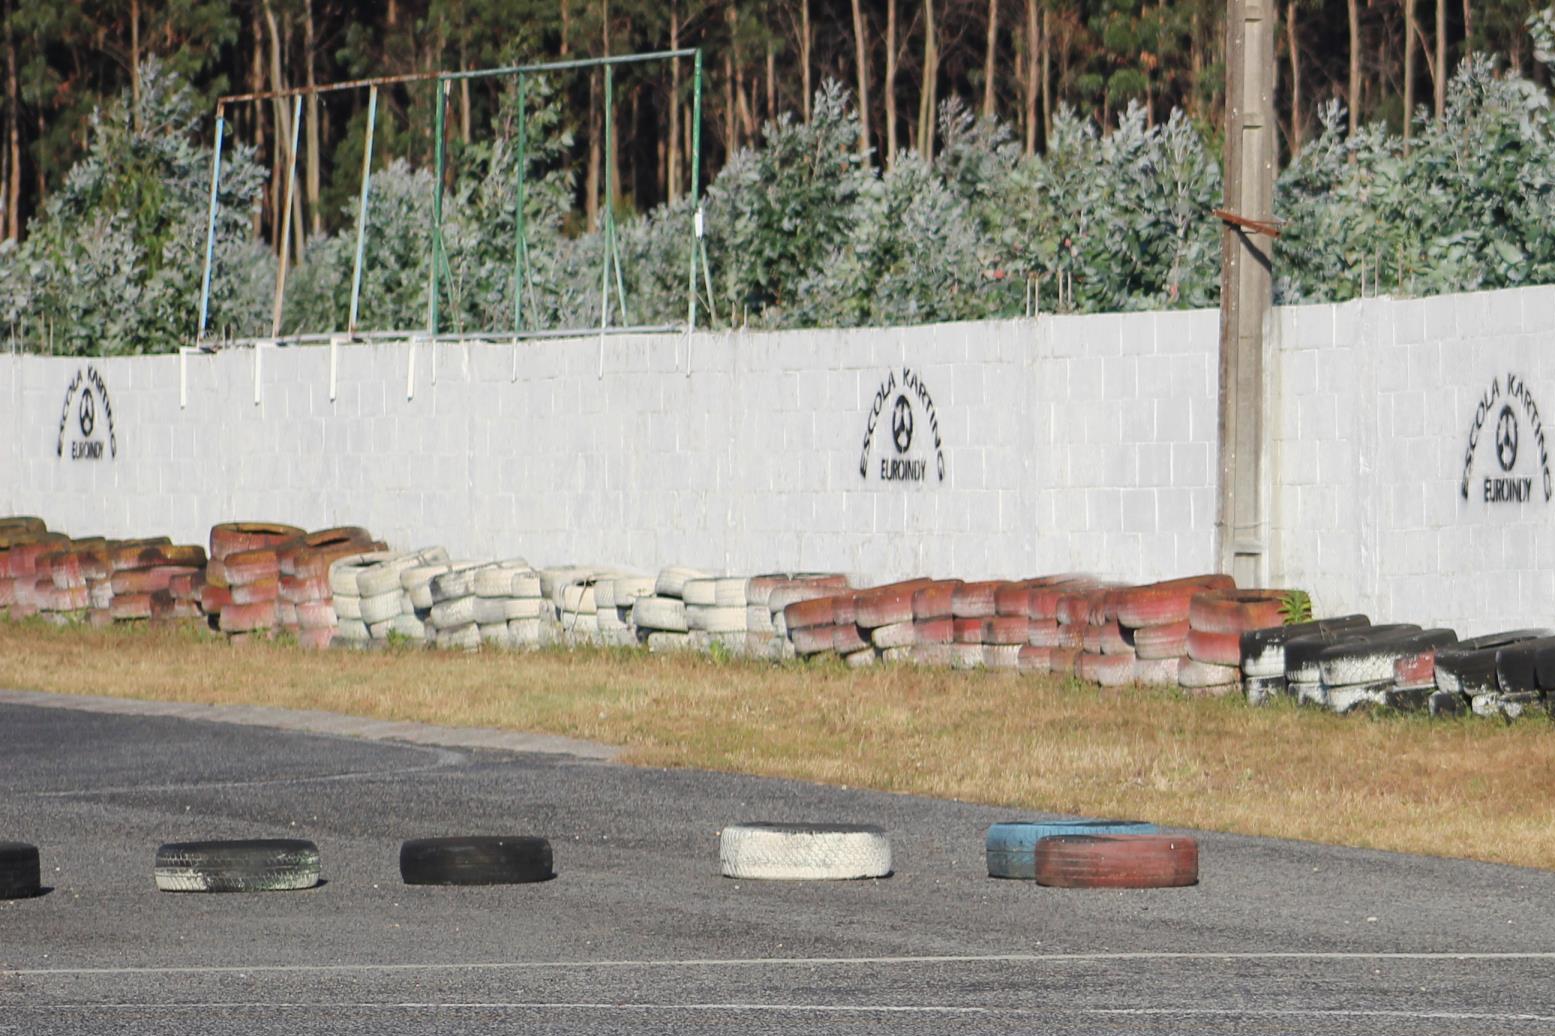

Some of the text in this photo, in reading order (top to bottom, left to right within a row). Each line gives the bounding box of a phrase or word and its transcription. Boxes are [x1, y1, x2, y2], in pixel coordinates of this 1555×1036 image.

[860, 366, 946, 482] ESCOLA KARTING
[1461, 372, 1552, 503] ESCOLA KARTING
[880, 458, 927, 481] EUROINDY
[1483, 477, 1532, 503] EUROINDY
